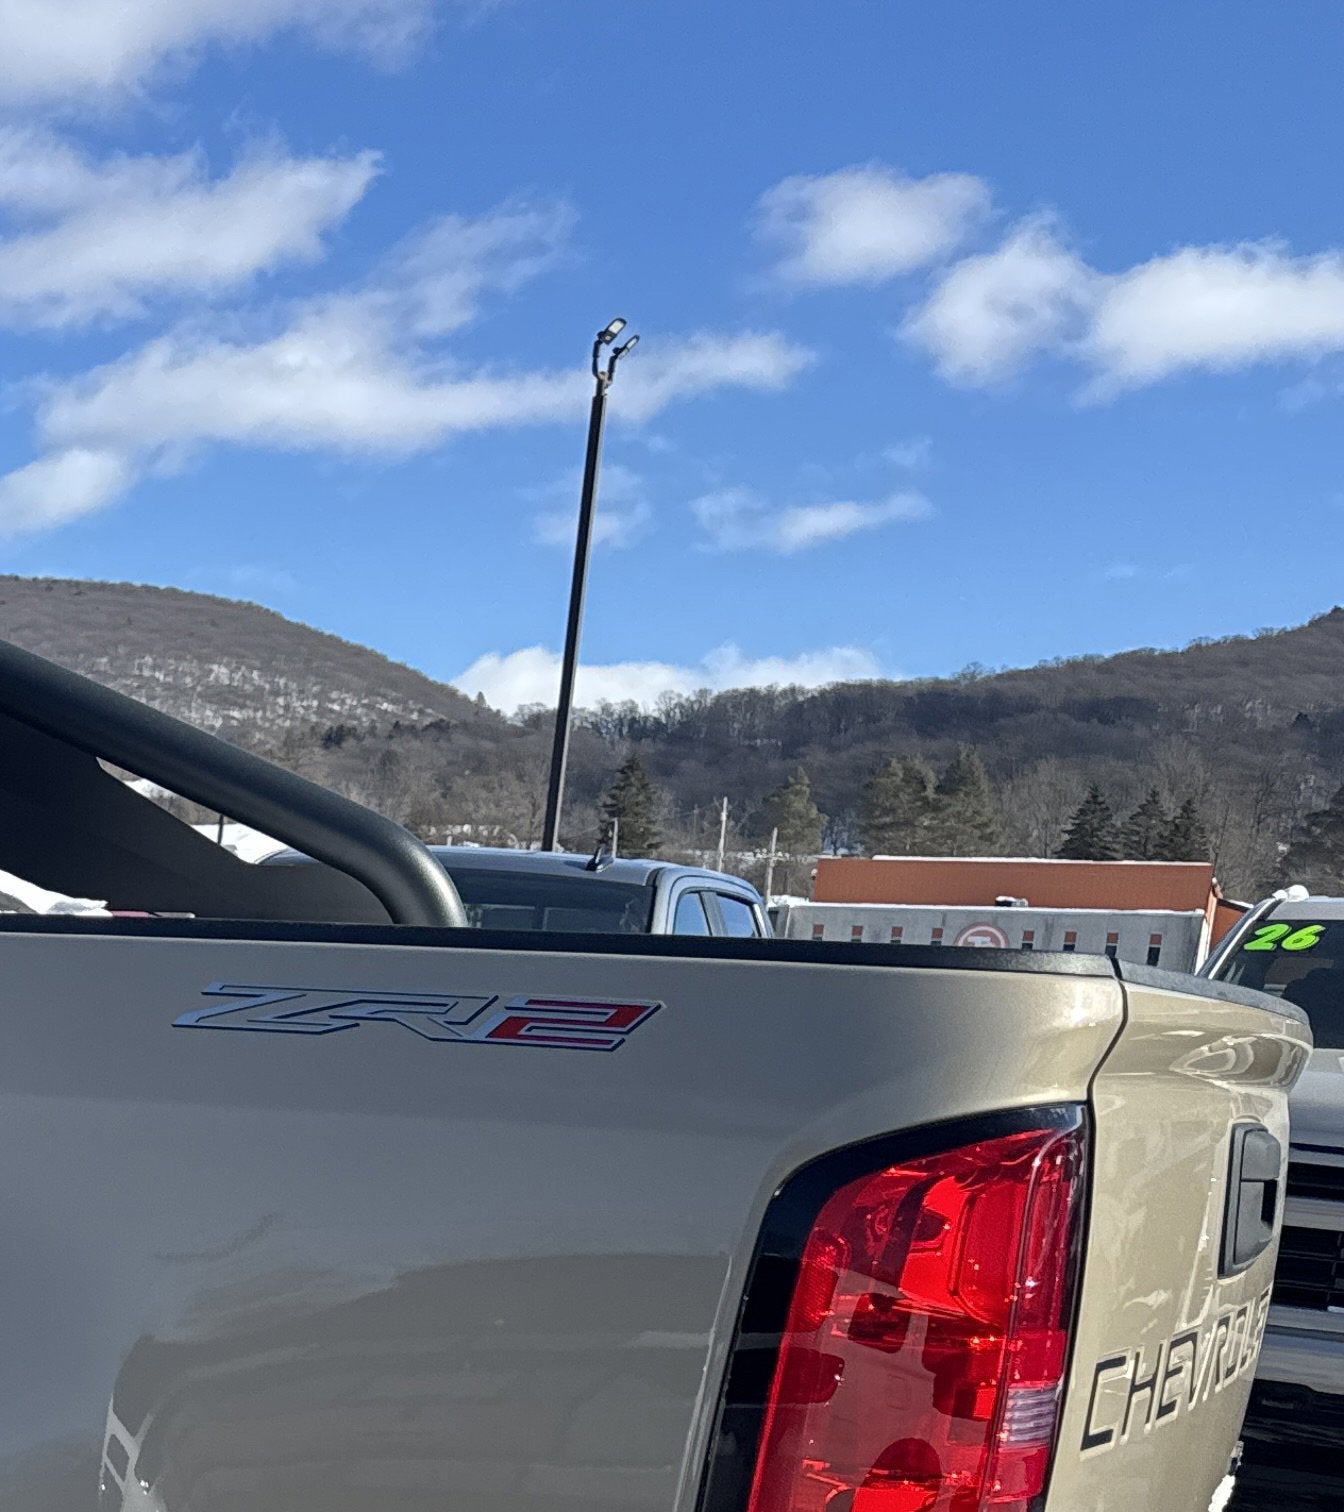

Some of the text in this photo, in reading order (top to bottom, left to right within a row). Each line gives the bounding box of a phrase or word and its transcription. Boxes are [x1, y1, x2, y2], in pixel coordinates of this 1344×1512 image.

[1243, 924, 1326, 952] 26
[171, 981, 668, 1051] ZR2
[1080, 1286, 1272, 1456] CHEVROLE
